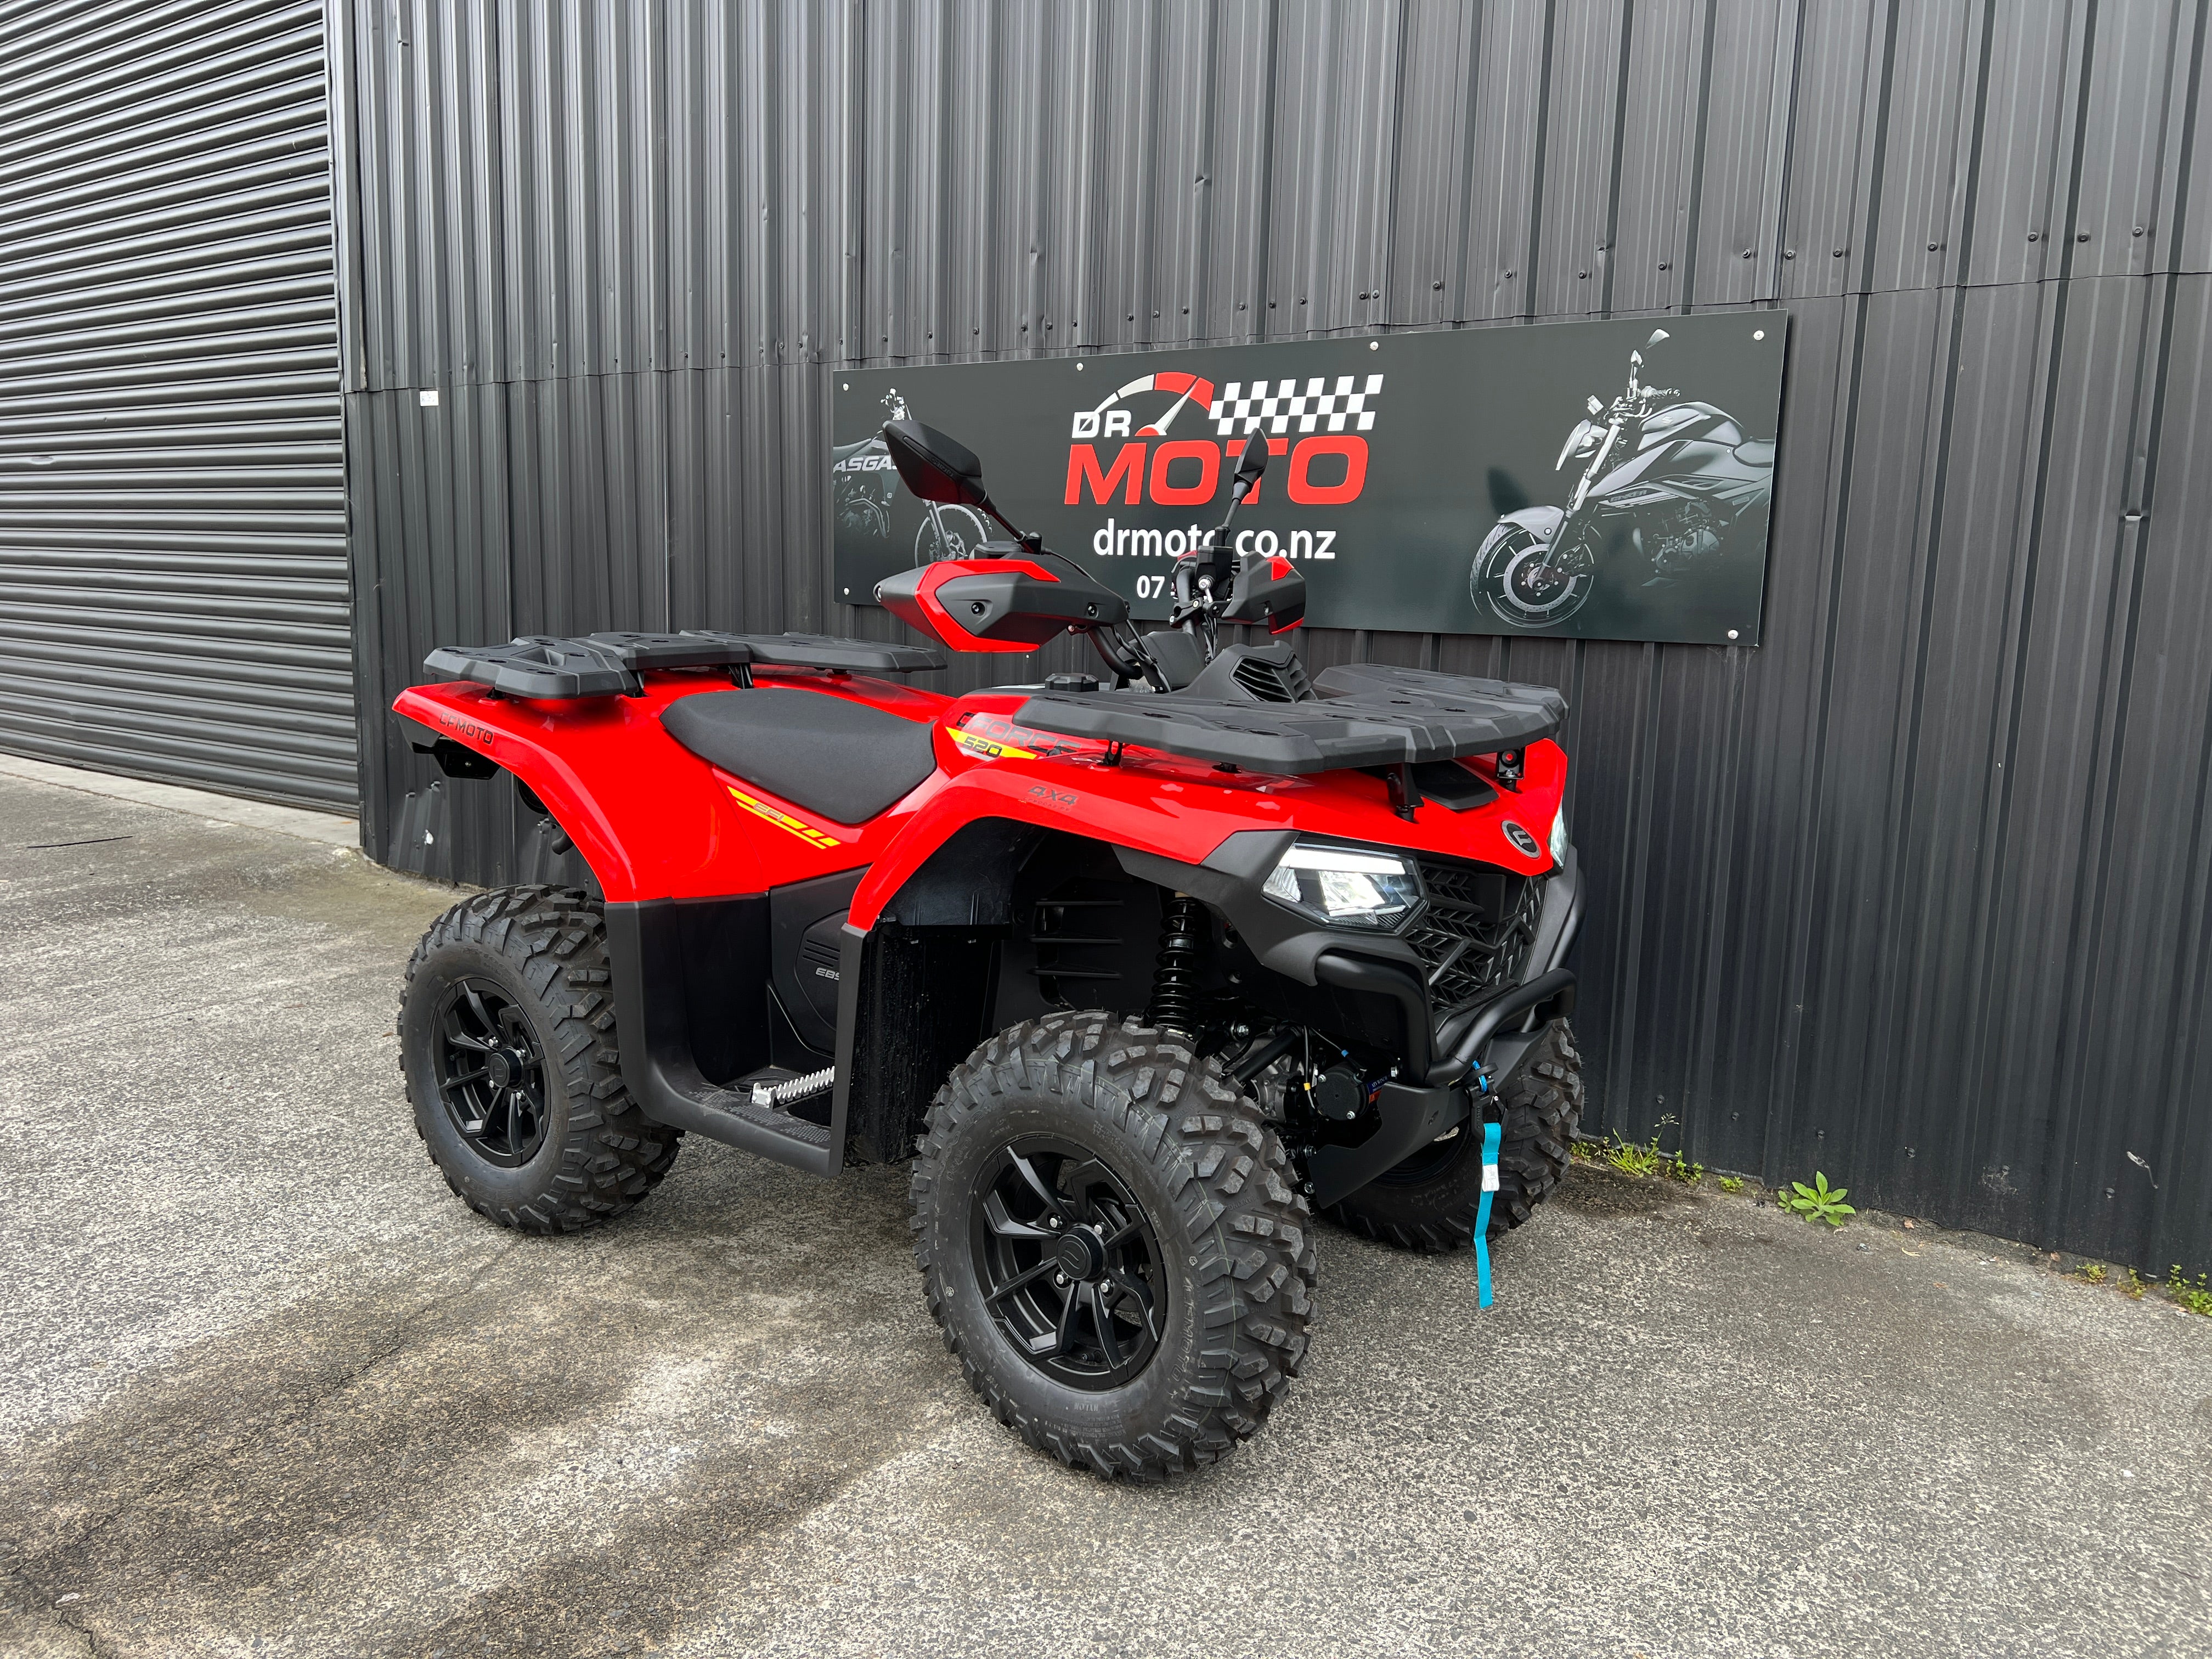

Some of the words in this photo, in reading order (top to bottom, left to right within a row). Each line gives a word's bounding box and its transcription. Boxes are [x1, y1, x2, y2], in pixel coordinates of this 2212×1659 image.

[1071, 410, 1132, 438] DR
[833, 456, 898, 473] ASGA
[1136, 575, 1165, 599] 07
[439, 712, 493, 744] CFMOTO
[956, 712, 1082, 757] CFORCE
[962, 736, 1002, 758] 520
[754, 803, 784, 822] EFI
